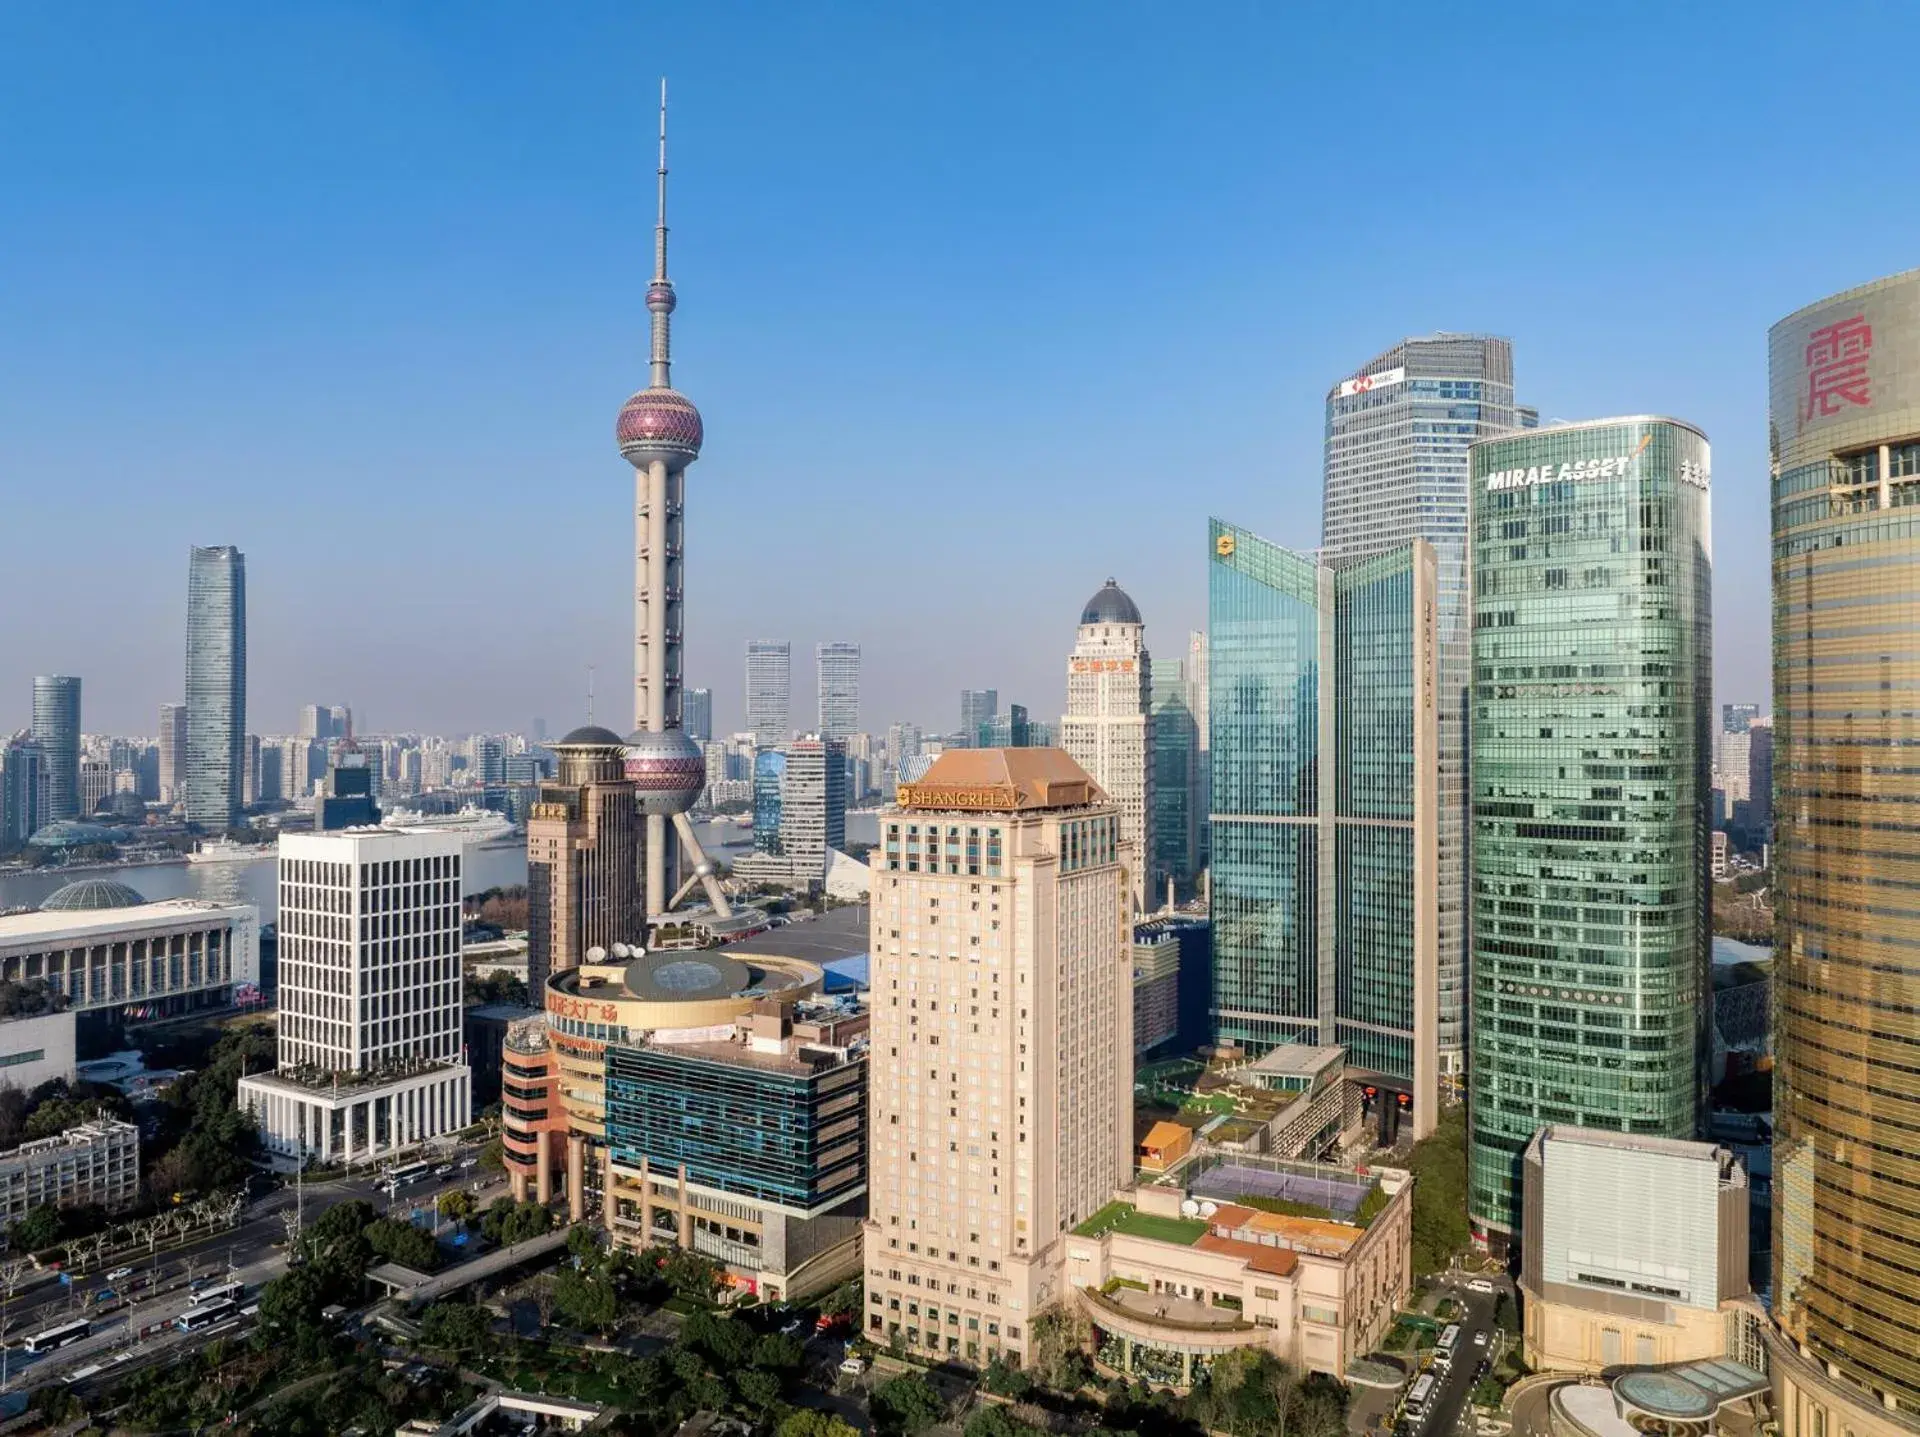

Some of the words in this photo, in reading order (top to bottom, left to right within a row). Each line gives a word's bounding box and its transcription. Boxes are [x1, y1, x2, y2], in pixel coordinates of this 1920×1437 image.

[1805, 314, 1872, 422] 震
[1487, 464, 1553, 491] MIRAE
[1557, 456, 1629, 482] ASSET
[913, 791, 1011, 807] SHANGRI-LA
